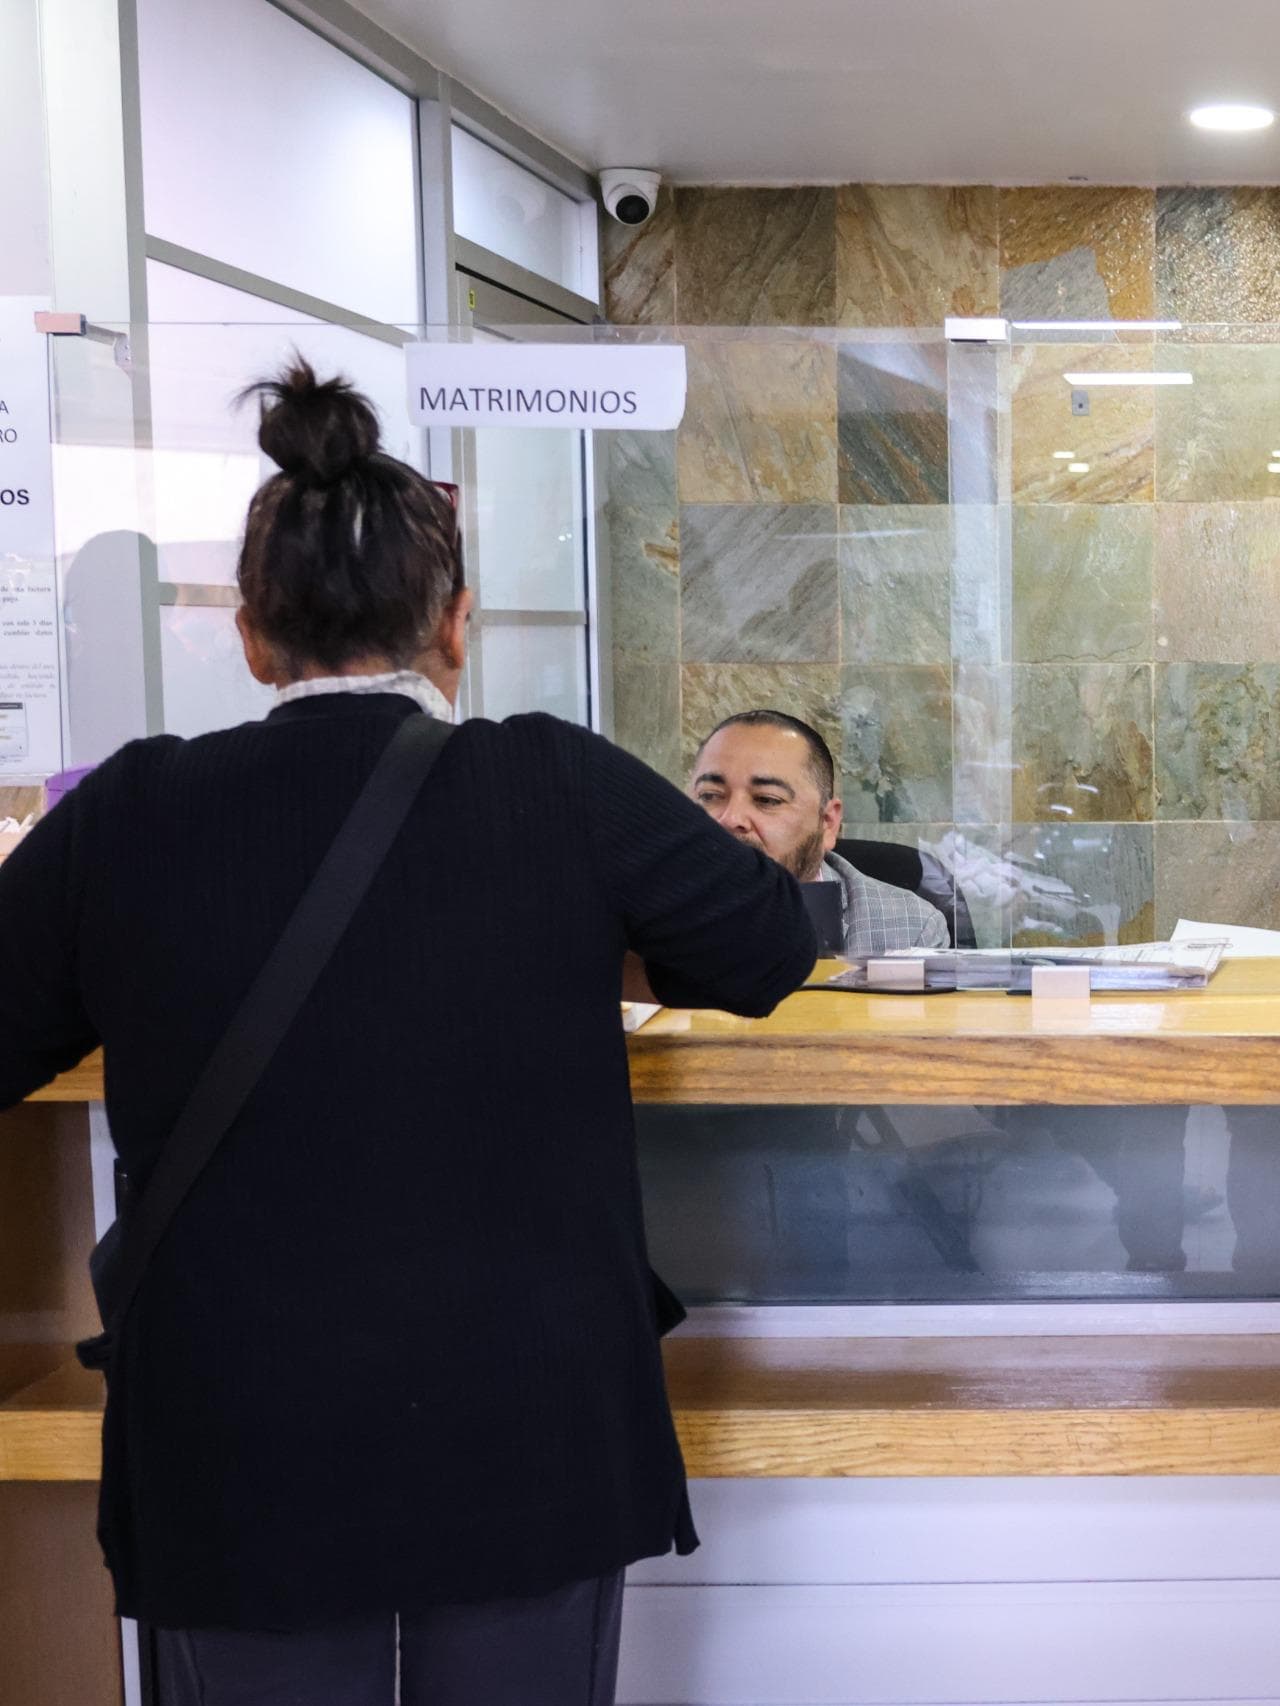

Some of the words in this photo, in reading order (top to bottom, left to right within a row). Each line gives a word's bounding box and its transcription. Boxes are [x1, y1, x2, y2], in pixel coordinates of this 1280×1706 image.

[420, 387, 637, 414] MATRIMONIOS
[0, 428, 17, 443] O
[0, 489, 29, 505] OS
